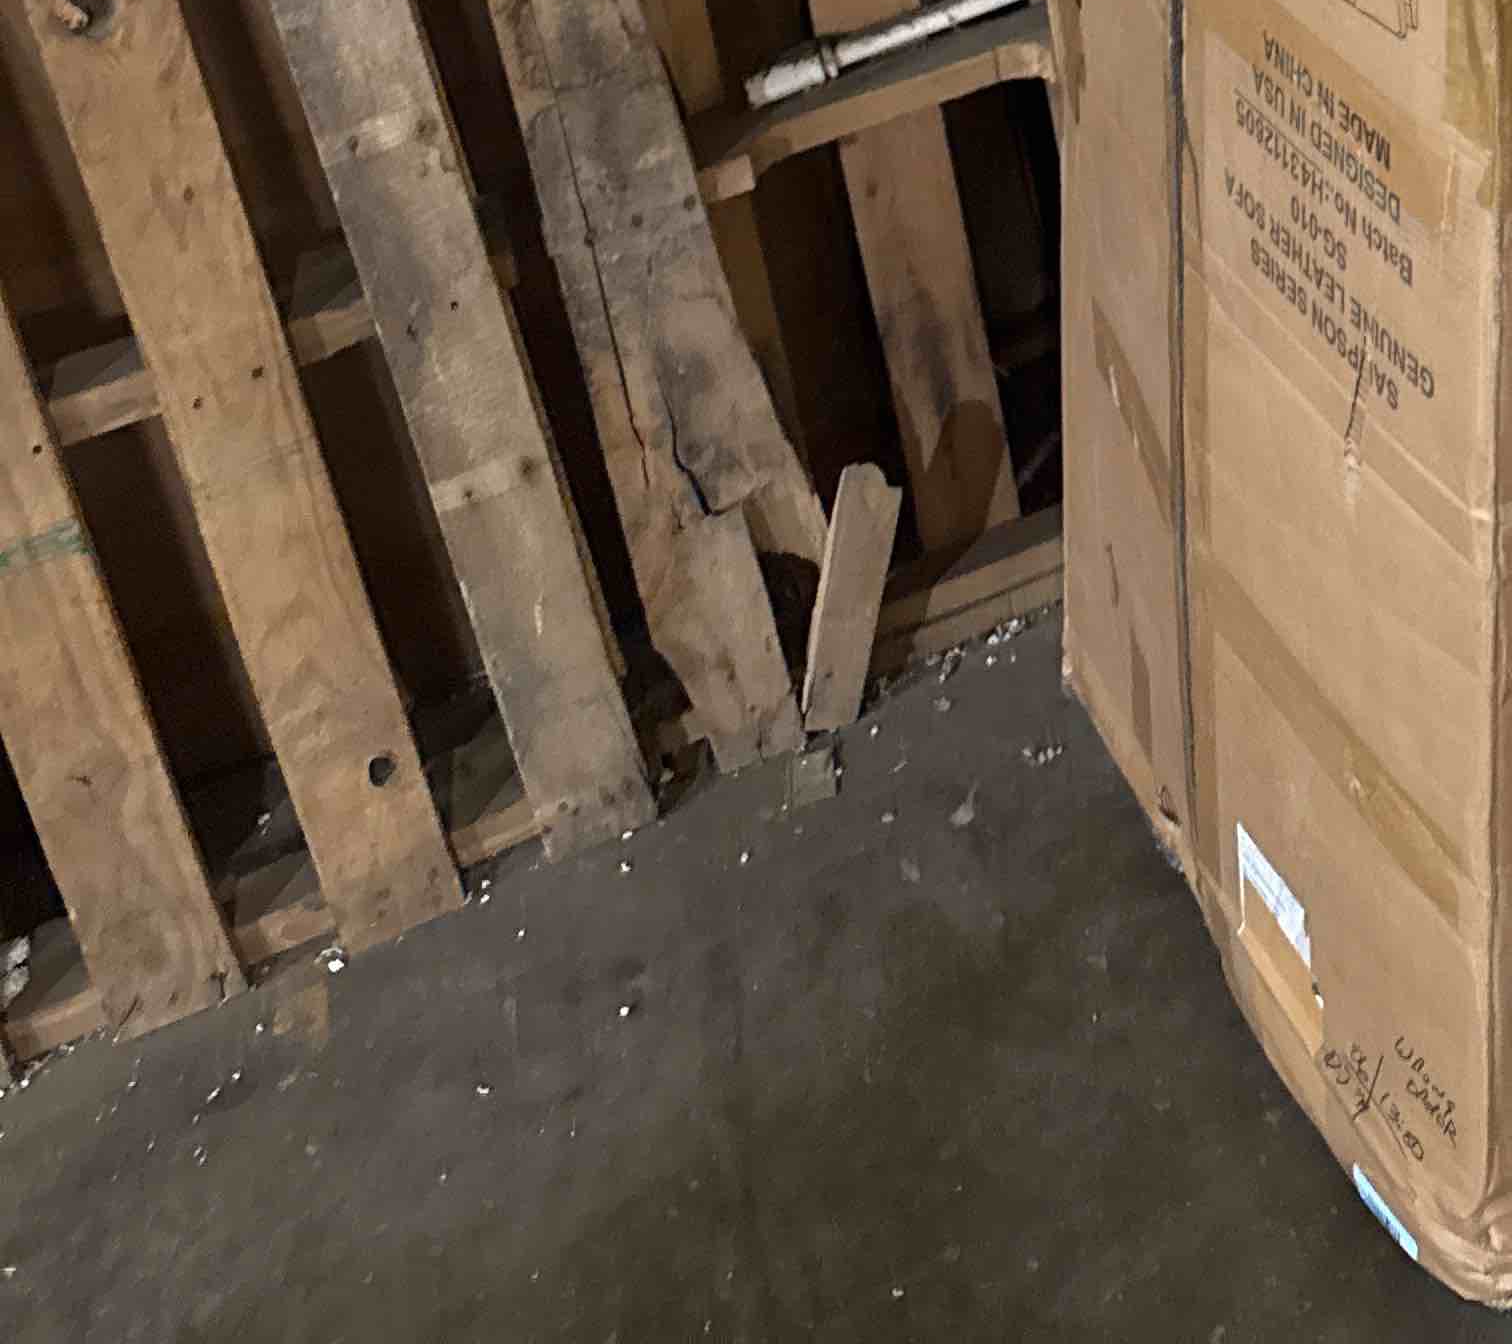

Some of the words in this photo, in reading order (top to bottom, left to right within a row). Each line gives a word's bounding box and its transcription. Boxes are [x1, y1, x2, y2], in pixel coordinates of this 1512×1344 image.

[1252, 63, 1285, 113] USA
[1263, 29, 1313, 97] CHINA
[1317, 79, 1335, 119] IN
[1289, 96, 1306, 137] IN
[1340, 100, 1391, 171] MADE
[1224, 167, 1265, 231] SOFA
[1310, 120, 1400, 225] DESIGNED
[1269, 218, 1345, 315] LEATHER
[1291, 195, 1347, 271] SG-010
[1362, 215, 1413, 288] Batch
[1250, 237, 1307, 315] SERIES
[1350, 296, 1435, 399] GENUINE
